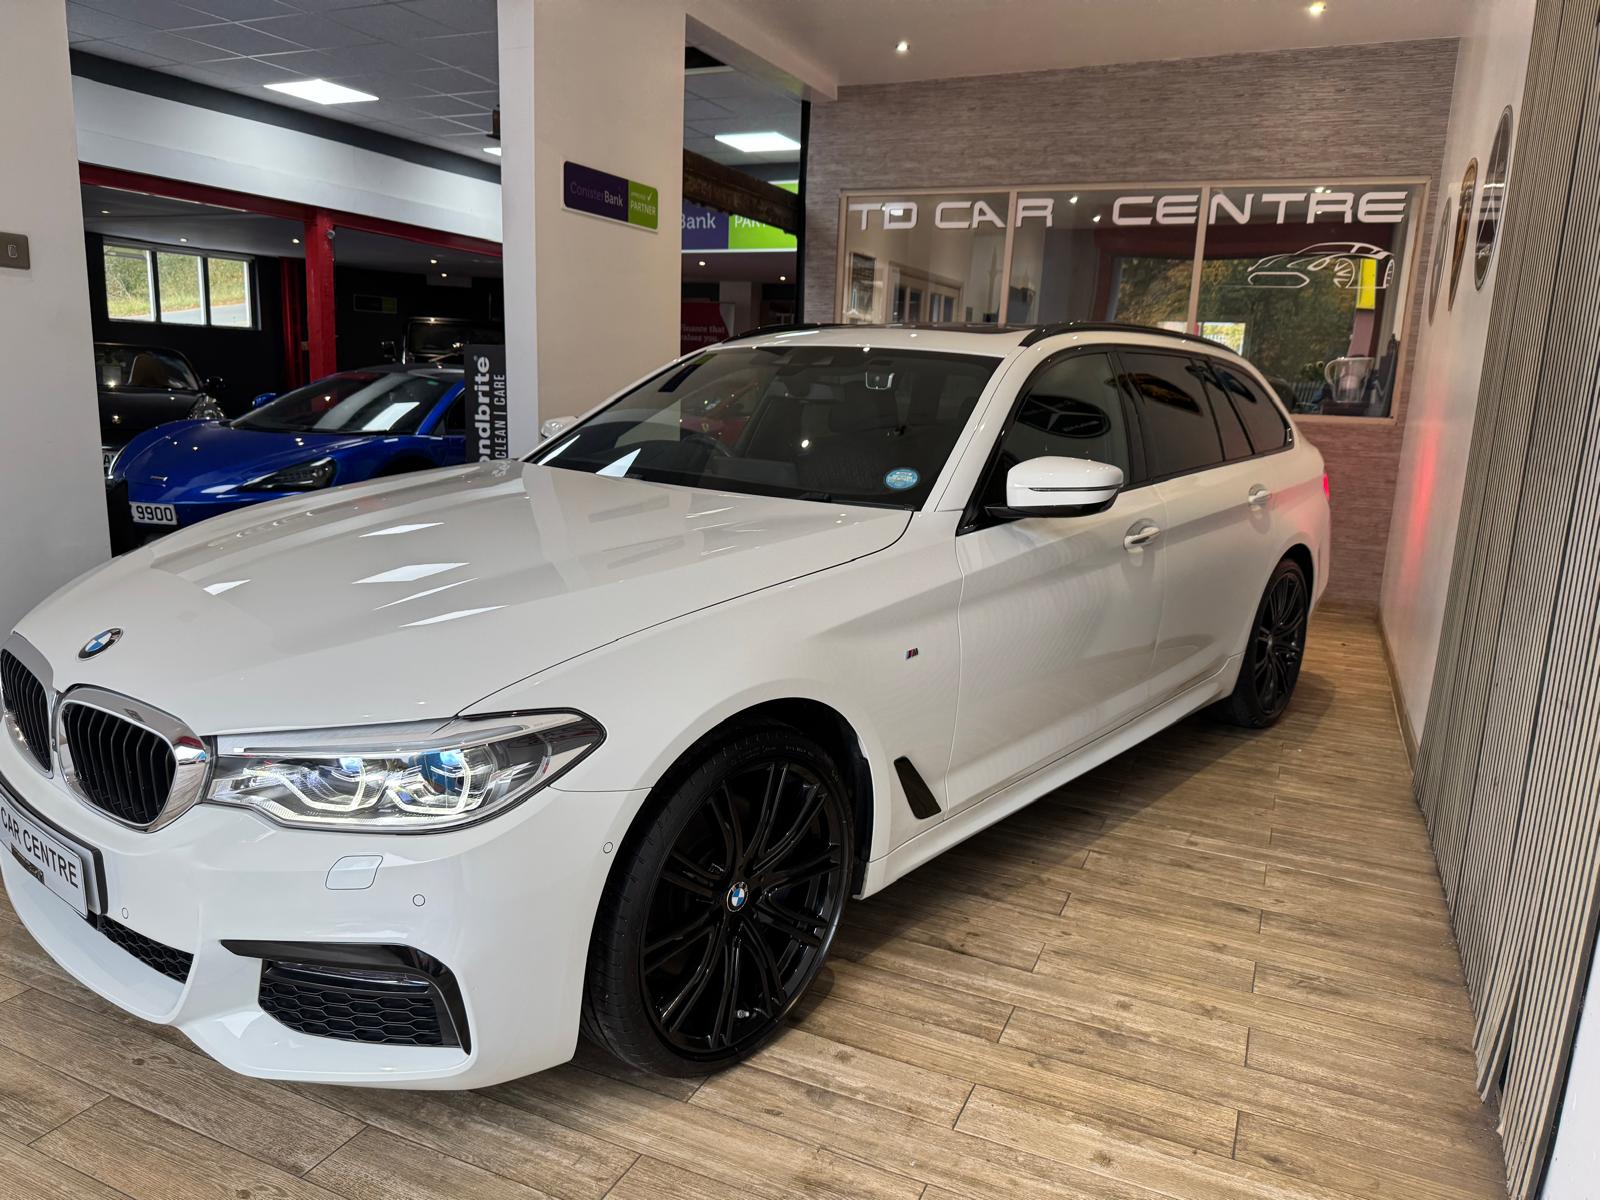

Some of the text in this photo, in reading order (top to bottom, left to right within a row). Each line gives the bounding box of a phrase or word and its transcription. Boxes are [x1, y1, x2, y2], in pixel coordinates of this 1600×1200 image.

[630, 199, 657, 217] PARTNER
[850, 190, 1410, 231] TD CAR CENTRE
[493, 374, 506, 406] CARE
[494, 420, 507, 459] CLEAN
[136, 505, 174, 522] 9900
[0, 806, 21, 845] CAR
[23, 829, 79, 889] CENTRE
